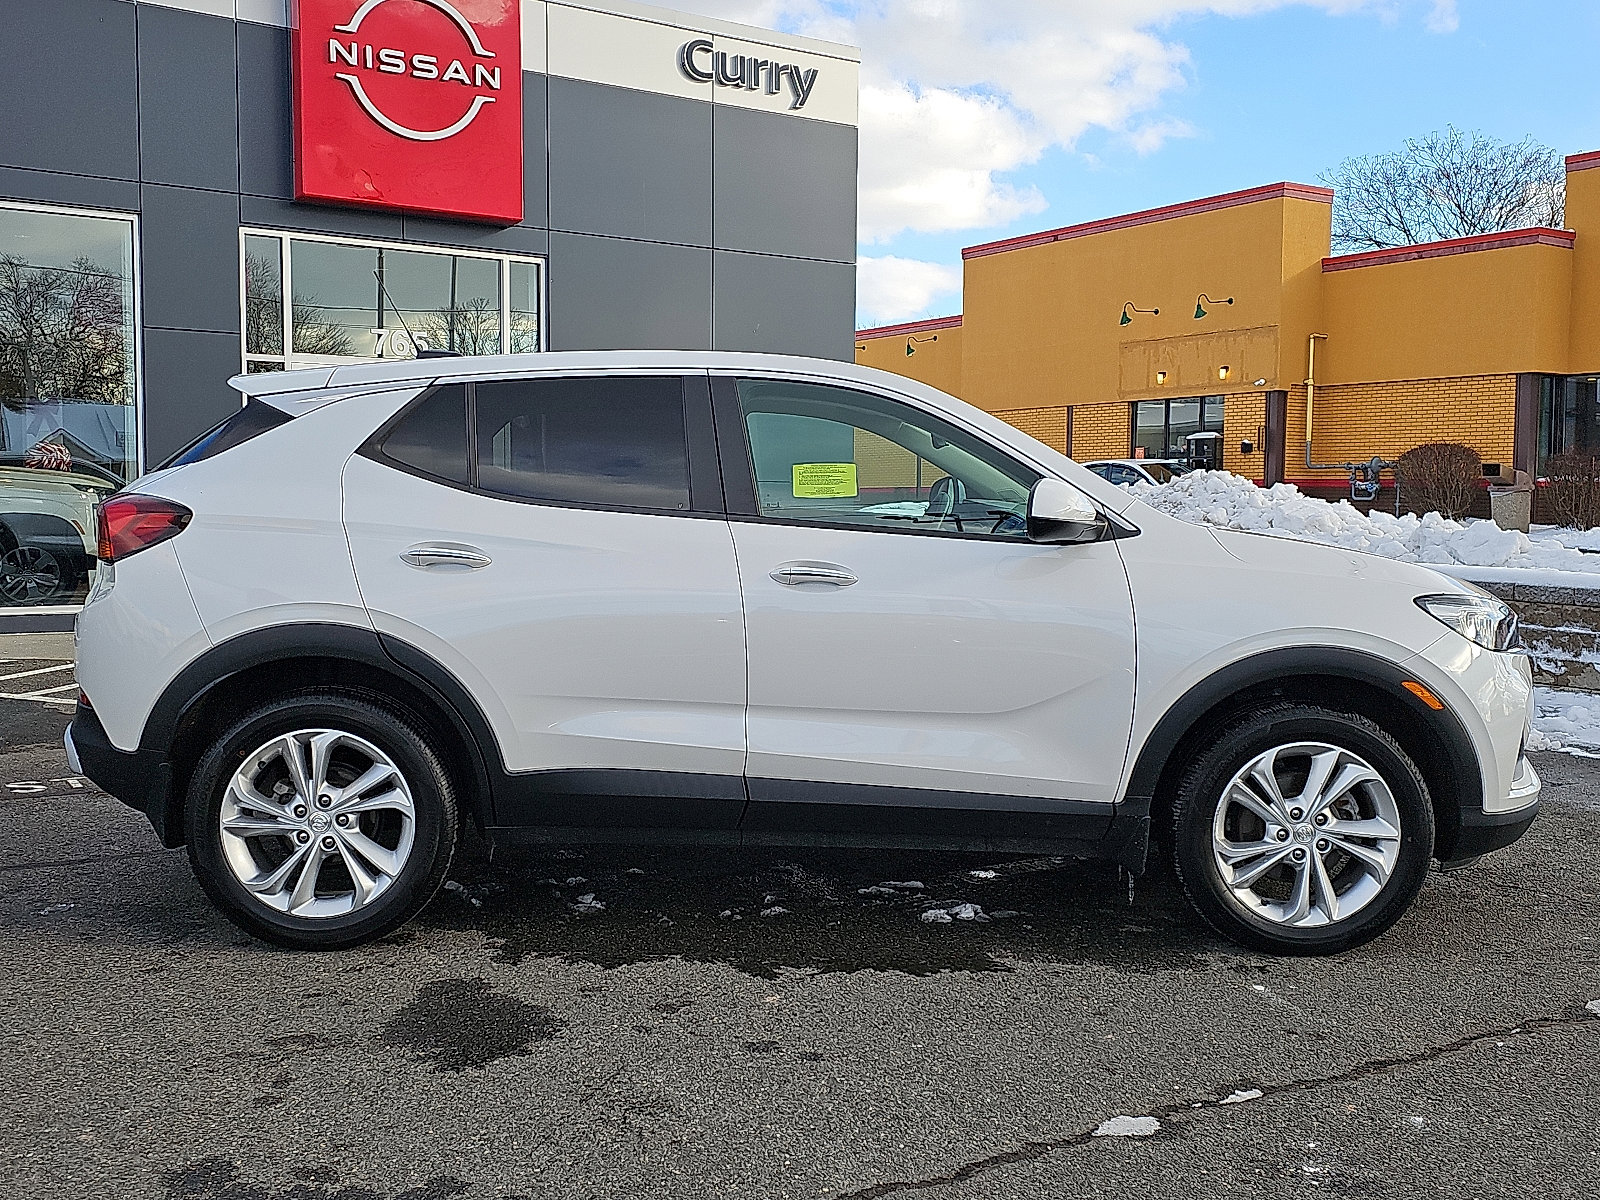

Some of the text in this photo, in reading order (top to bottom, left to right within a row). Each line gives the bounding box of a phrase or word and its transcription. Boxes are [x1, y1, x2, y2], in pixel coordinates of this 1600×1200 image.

[329, 38, 501, 90] NISSAN
[676, 38, 819, 110] Curry
[370, 328, 429, 357] 765
